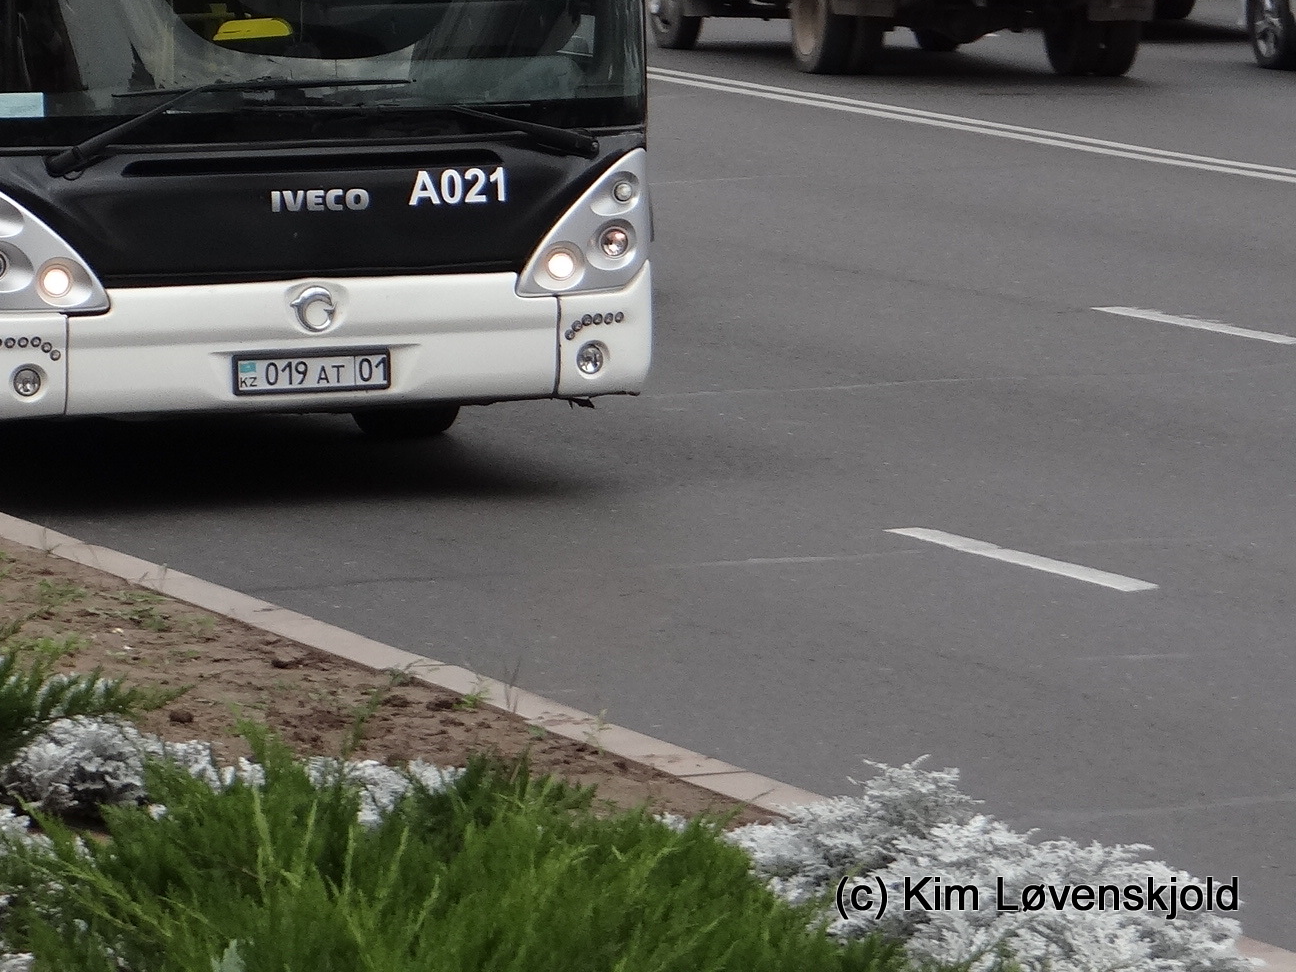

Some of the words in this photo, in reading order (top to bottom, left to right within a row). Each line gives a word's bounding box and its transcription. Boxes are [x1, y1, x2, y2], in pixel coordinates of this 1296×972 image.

[271, 188, 370, 213] IVECO
[408, 166, 506, 206] A021
[240, 376, 257, 388] KZ
[265, 360, 308, 386] 019
[316, 364, 345, 384] AT
[358, 356, 387, 382] 01
